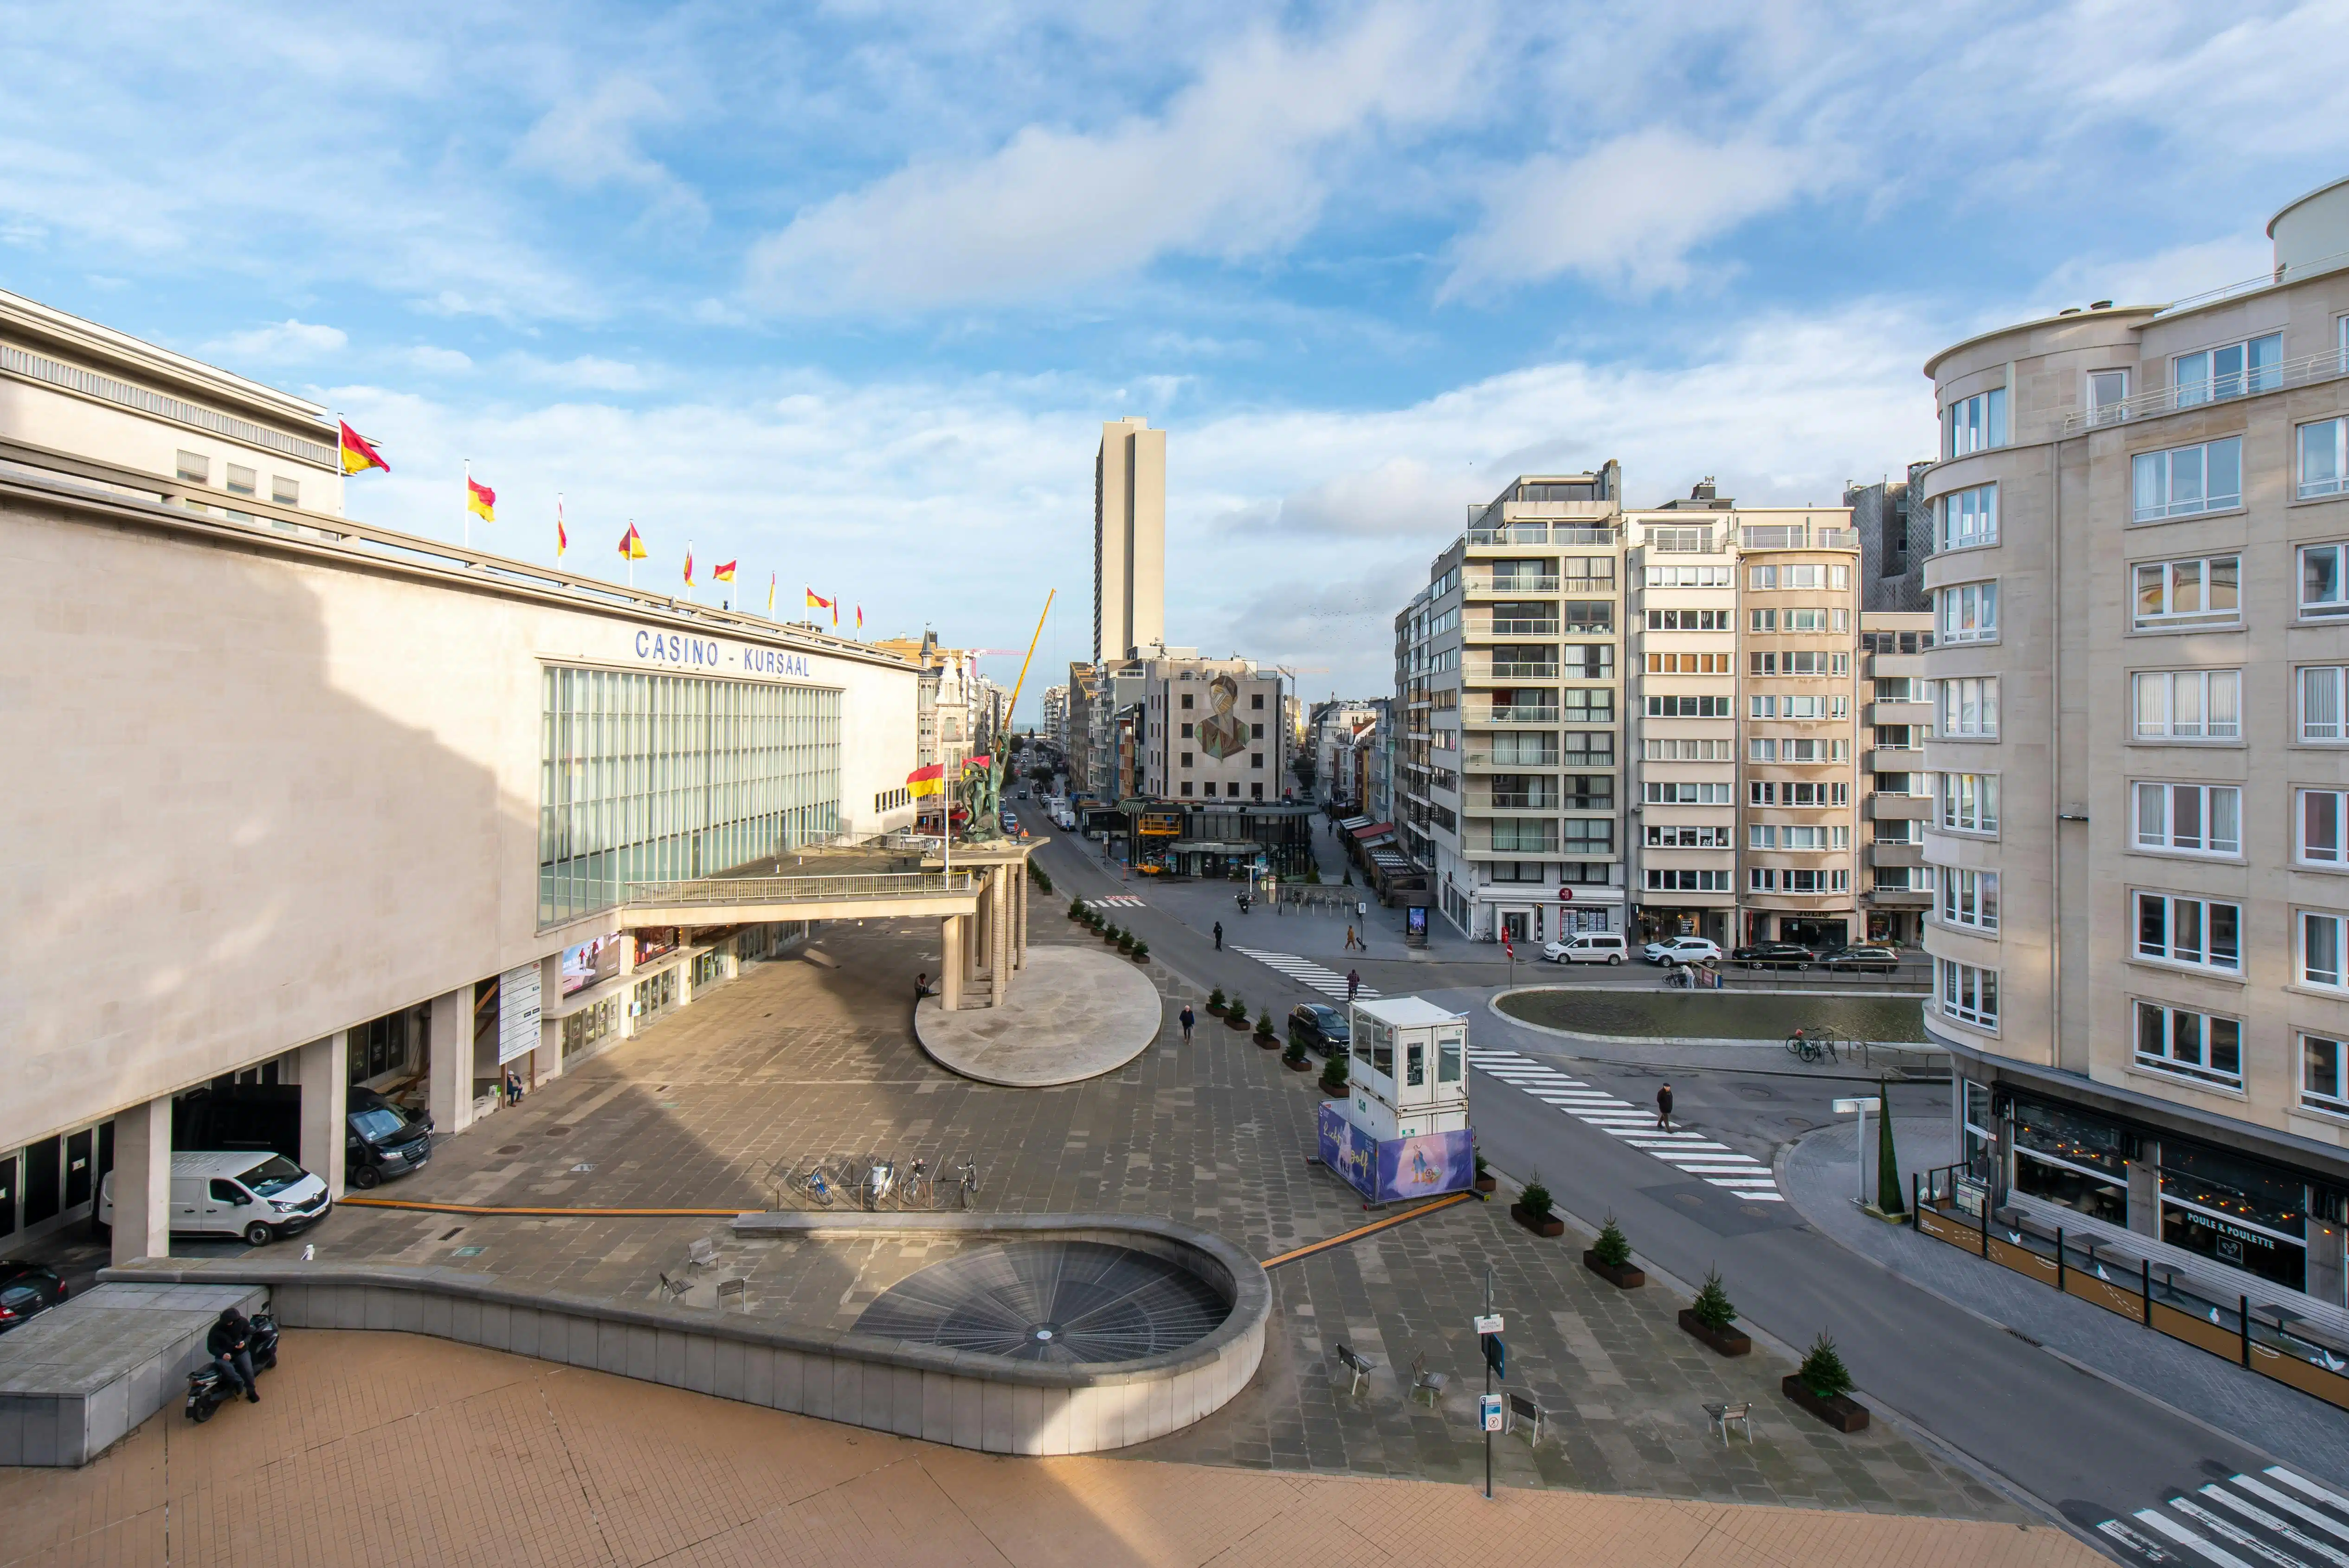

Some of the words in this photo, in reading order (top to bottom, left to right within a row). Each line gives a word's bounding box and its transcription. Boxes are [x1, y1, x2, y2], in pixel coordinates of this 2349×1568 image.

[636, 630, 718, 666] CASINO
[745, 648, 809, 677] KURSAAL
[2187, 1212, 2217, 1229] POULE
[2218, 1223, 2226, 1233] &
[2227, 1226, 2275, 1250] POULETTE
